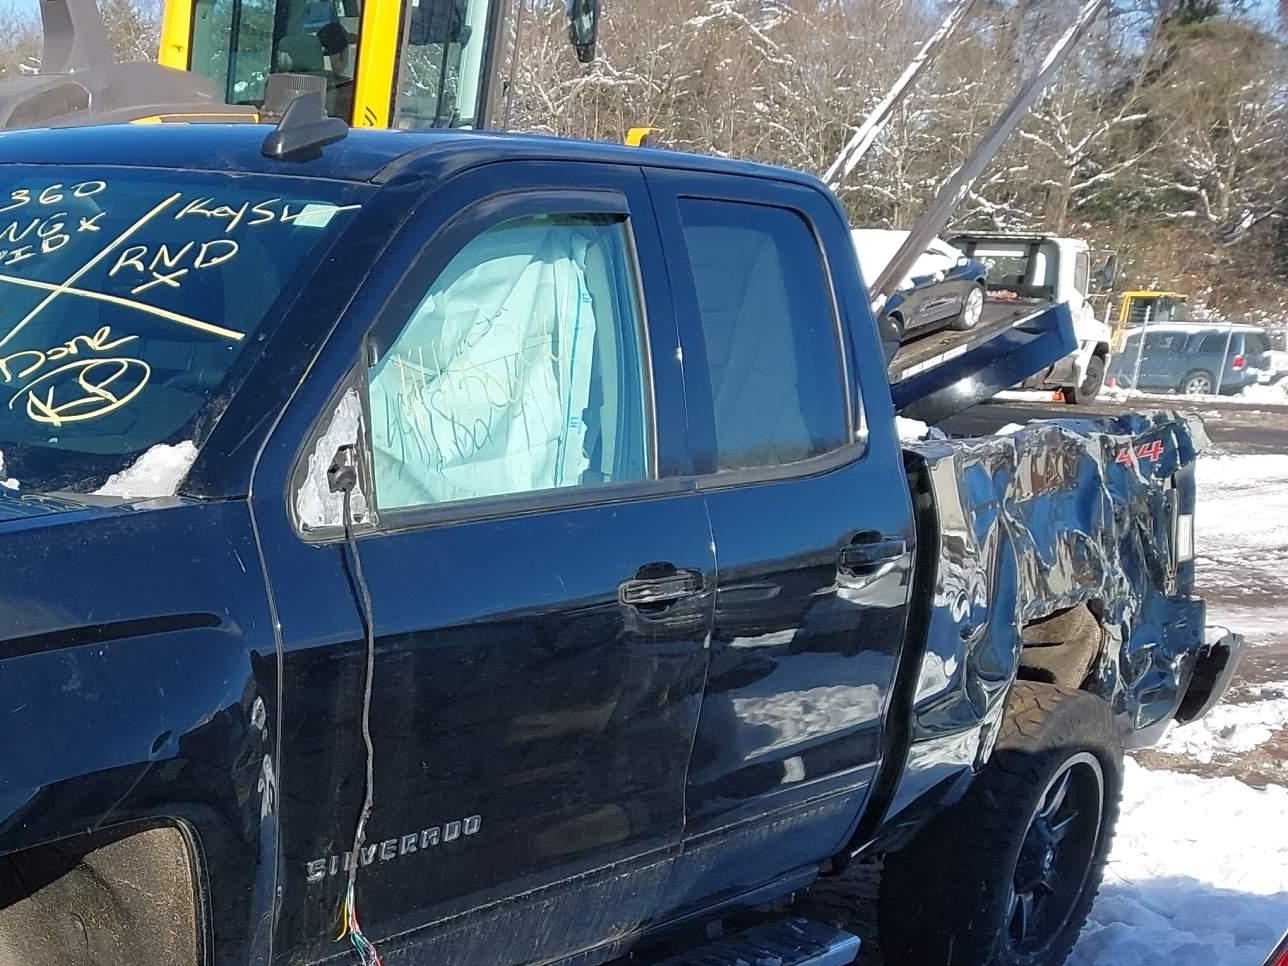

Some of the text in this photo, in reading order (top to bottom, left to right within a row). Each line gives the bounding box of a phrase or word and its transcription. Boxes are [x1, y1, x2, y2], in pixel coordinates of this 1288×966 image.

[109, 239, 239, 276] RND
[1115, 440, 1165, 467] 44
[306, 814, 482, 882] SILVERADO
